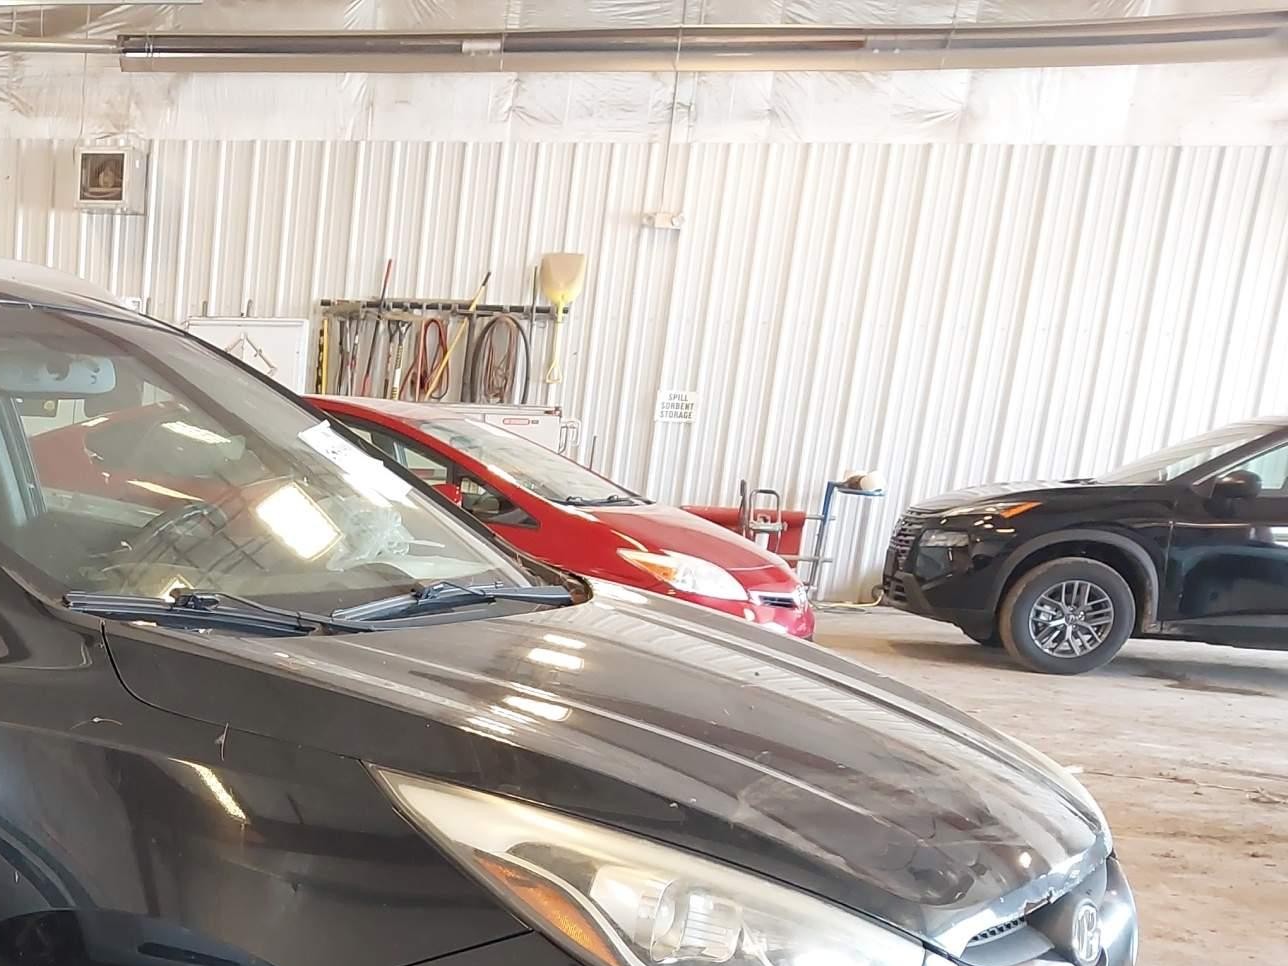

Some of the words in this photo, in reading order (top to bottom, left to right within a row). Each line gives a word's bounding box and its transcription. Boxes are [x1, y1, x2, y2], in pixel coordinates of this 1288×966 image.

[668, 393, 688, 402] SPILL
[661, 402, 694, 411] SORBENT
[659, 411, 692, 420] STORAGE
